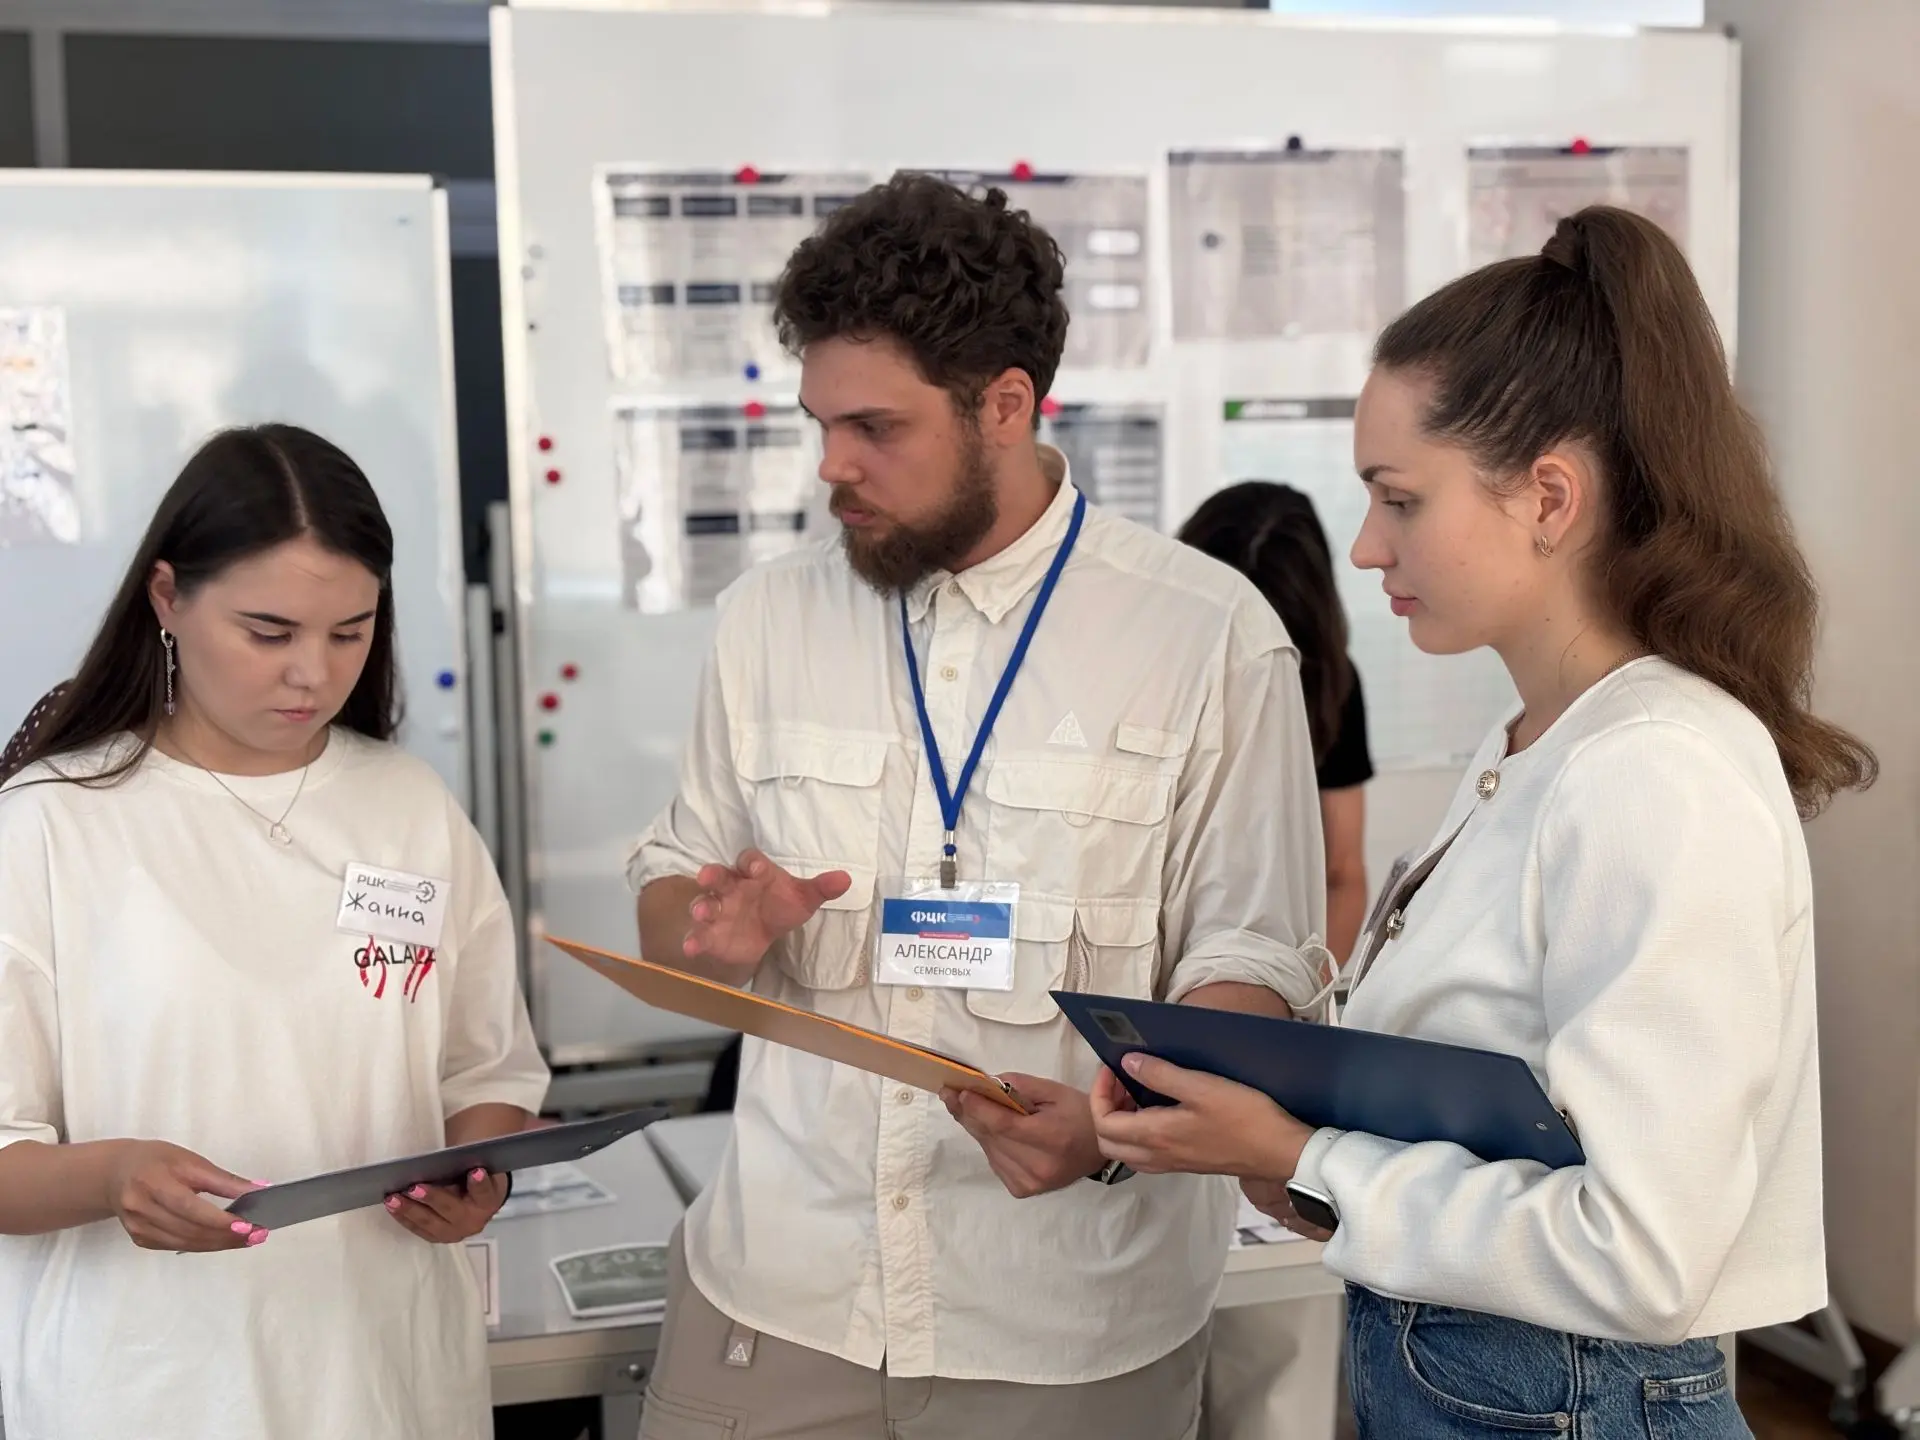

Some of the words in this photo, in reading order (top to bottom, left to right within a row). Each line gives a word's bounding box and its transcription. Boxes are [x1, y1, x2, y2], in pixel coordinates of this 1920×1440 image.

[357, 874, 386, 889] РЦК
[345, 890, 426, 926] Жанна
[894, 943, 993, 964] АЛЕКСАНДР
[913, 965, 972, 977] СЕМЕНОВЫХ
